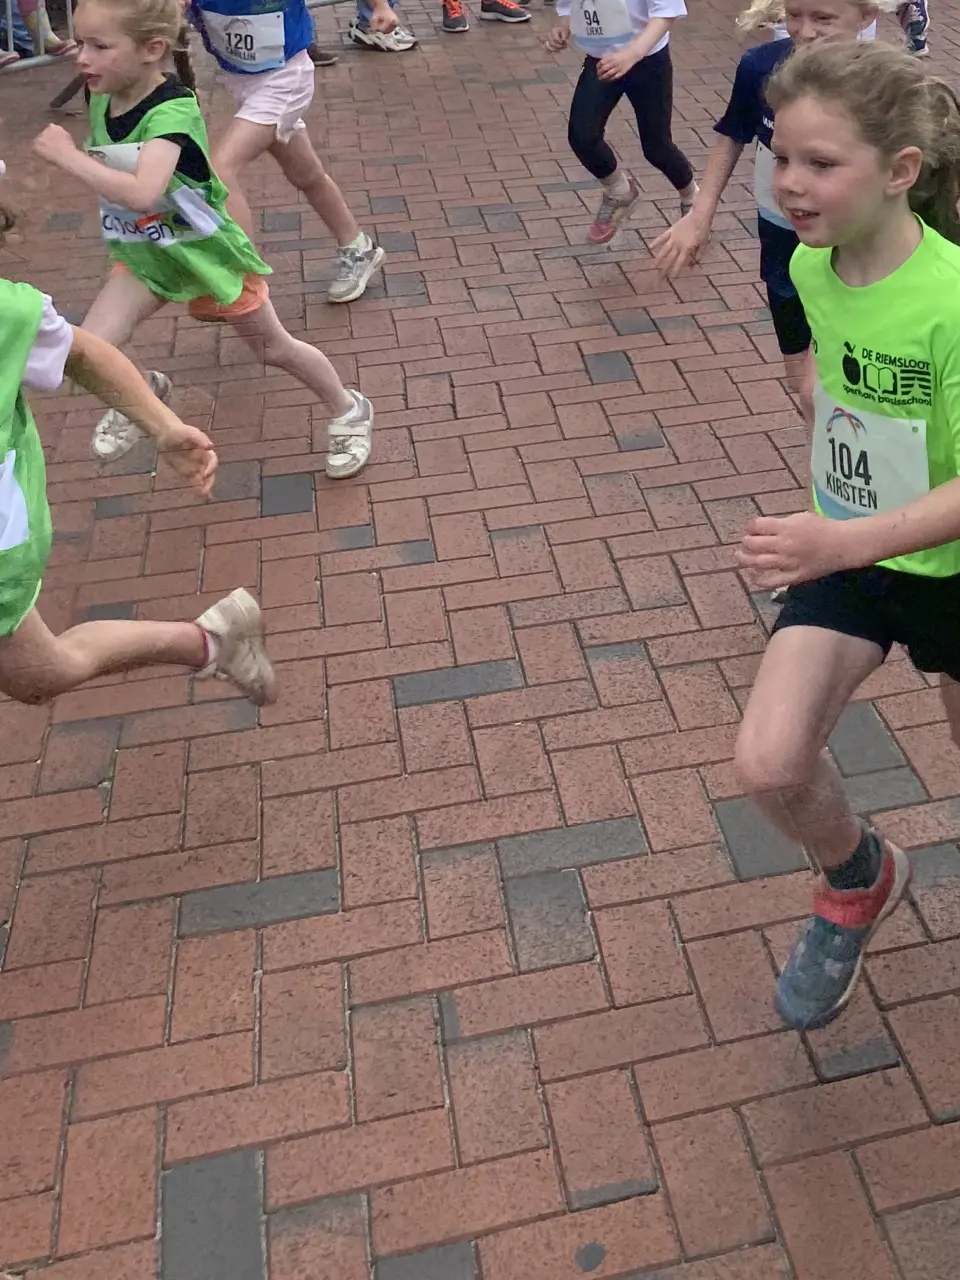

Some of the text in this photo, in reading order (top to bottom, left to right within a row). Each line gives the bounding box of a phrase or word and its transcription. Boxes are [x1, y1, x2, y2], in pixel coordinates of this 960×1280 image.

[583, 10, 600, 26] 94
[225, 32, 254, 52] 120
[585, 26, 604, 36] LIEKE
[861, 348, 931, 371] DE RIEMSLOOT
[842, 384, 932, 407] openbare basisschool
[828, 437, 873, 486] 104
[825, 471, 878, 510] KIRSTEN
